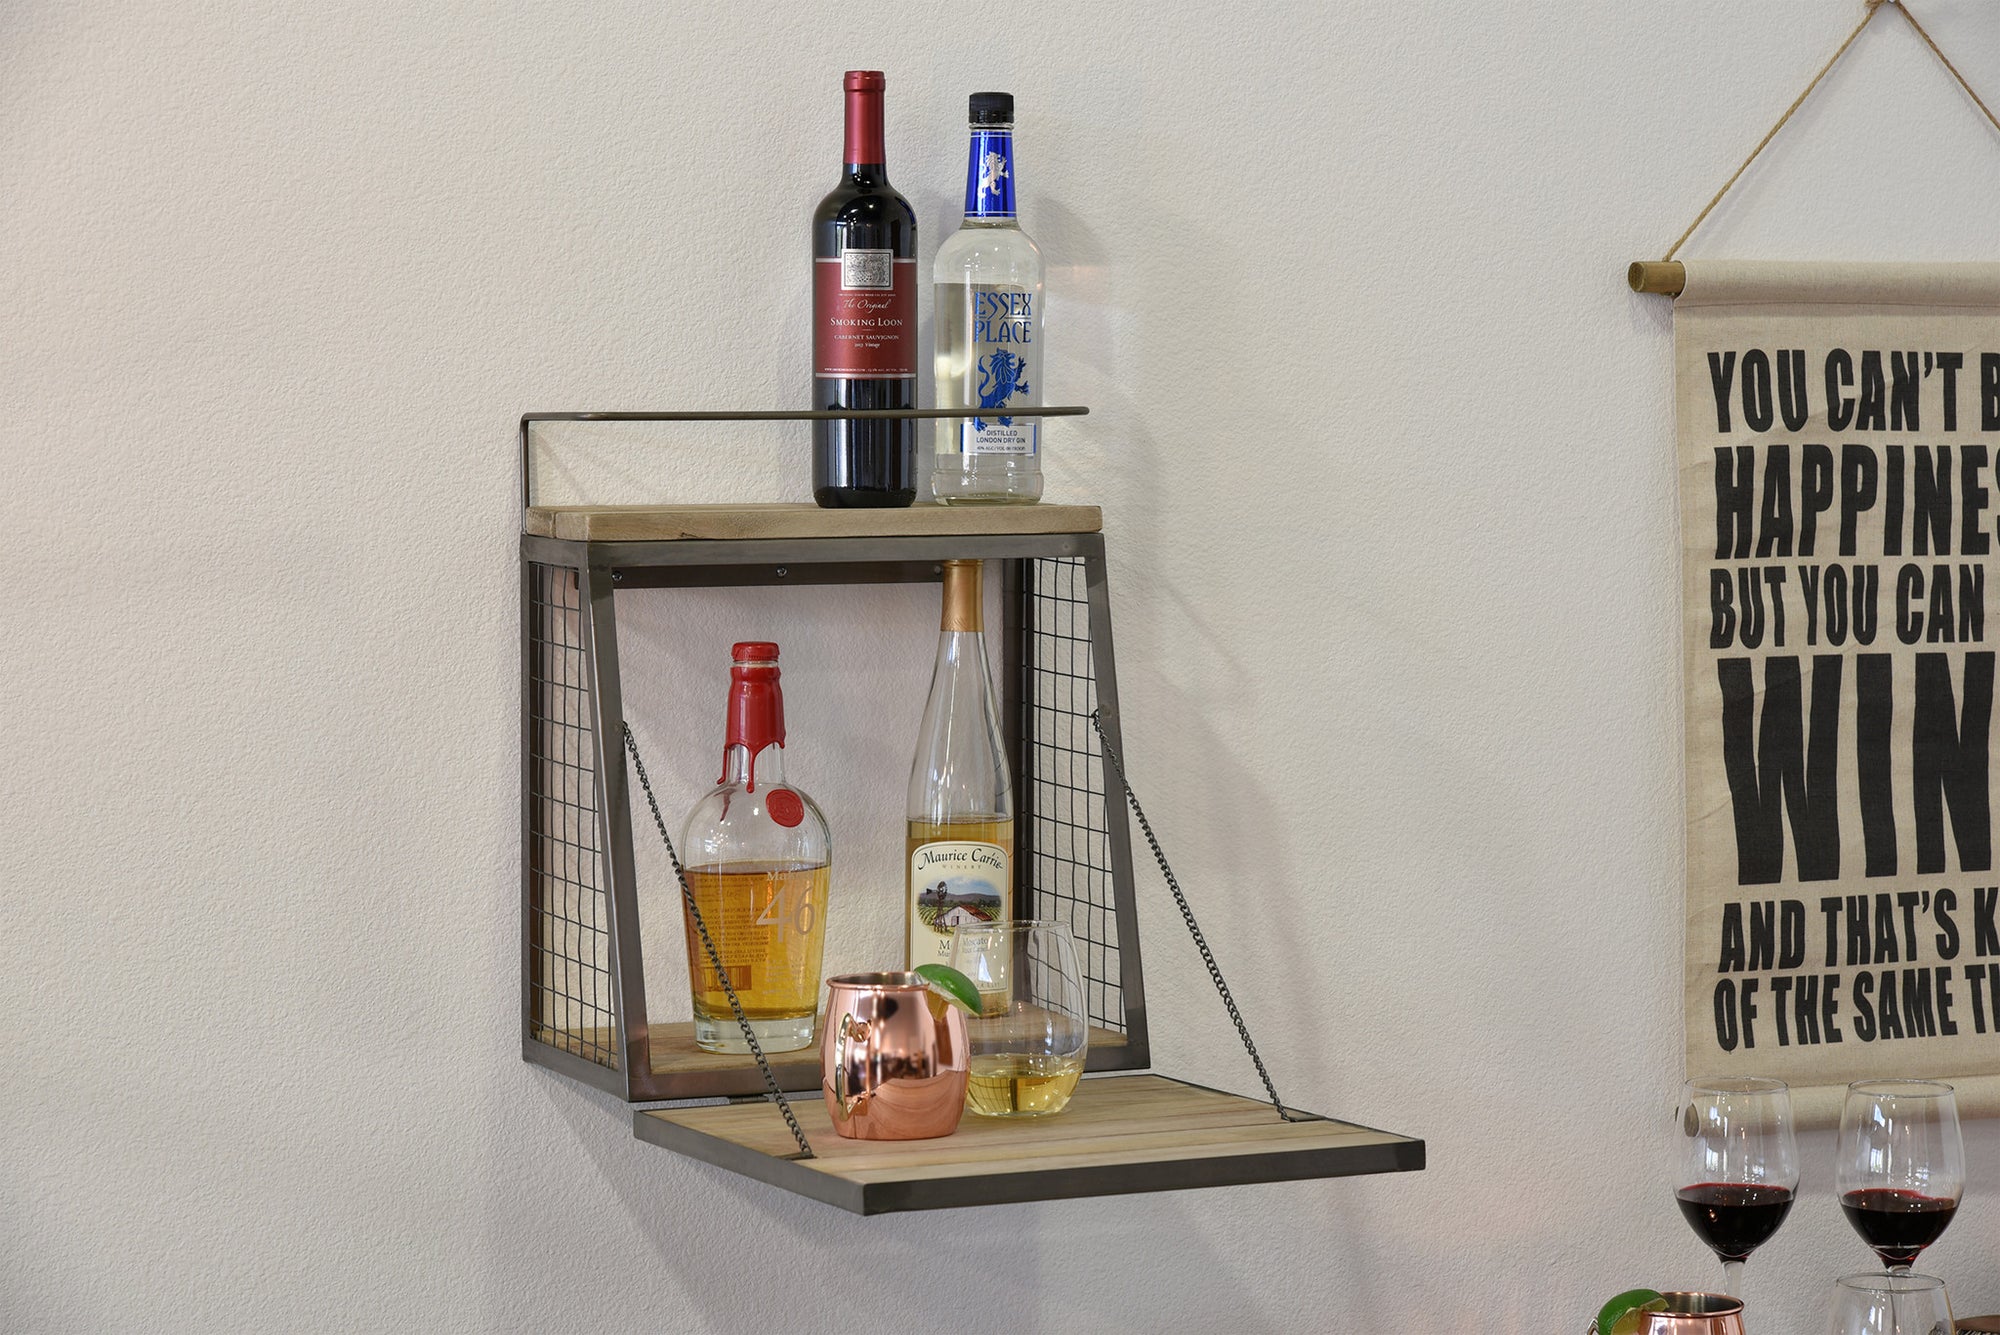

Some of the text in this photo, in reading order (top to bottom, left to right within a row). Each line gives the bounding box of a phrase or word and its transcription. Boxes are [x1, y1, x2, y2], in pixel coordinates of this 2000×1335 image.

[830, 317, 904, 327] SMOKING LOON
[843, 297, 889, 314] The Original
[973, 320, 1032, 344] PLACE
[974, 292, 1032, 320] ESSEX
[1708, 349, 1808, 432] YOU
[1825, 349, 1963, 432] CAN'T
[1714, 445, 2000, 559] HAPPINE
[1710, 563, 1984, 649] BUT YOU CAN
[1718, 652, 1995, 885] WIN
[917, 849, 968, 870] Maurice
[756, 885, 816, 943] 46
[1718, 900, 1805, 973] AND
[1821, 890, 1959, 967] THAT'S
[1714, 978, 1758, 1052] OF
[1771, 974, 1842, 1047] THE
[1853, 967, 1958, 1043] SAME
